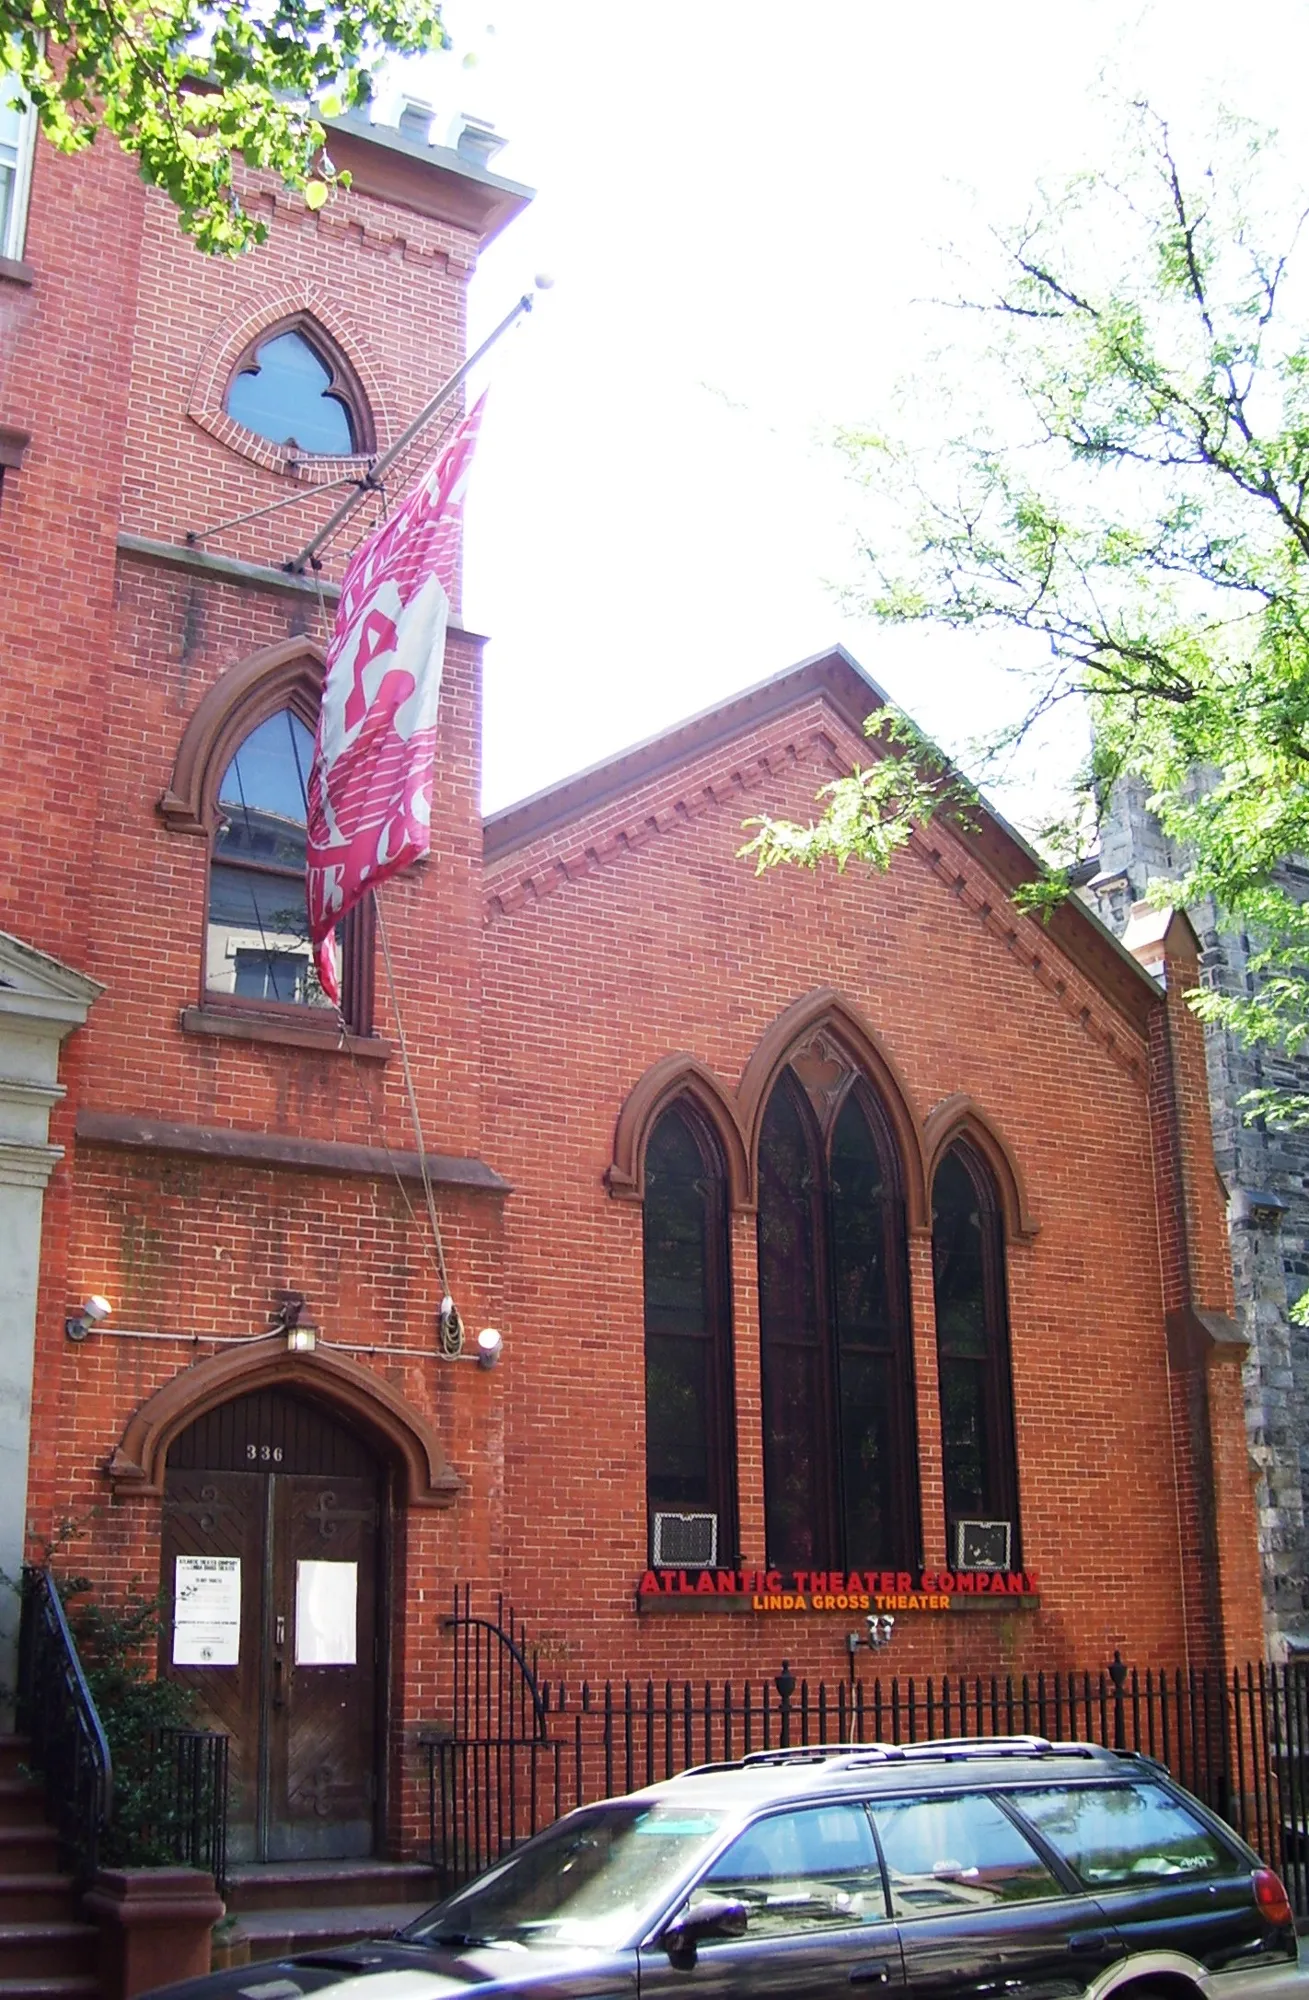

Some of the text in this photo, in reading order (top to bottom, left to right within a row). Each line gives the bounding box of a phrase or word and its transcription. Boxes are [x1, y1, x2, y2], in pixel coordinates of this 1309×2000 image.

[246, 1444, 283, 1462] 336
[640, 1570, 1041, 1594] ATLANTIC THEATER COMPANY
[752, 1595, 950, 1610] LINDA GROSS THEATER
